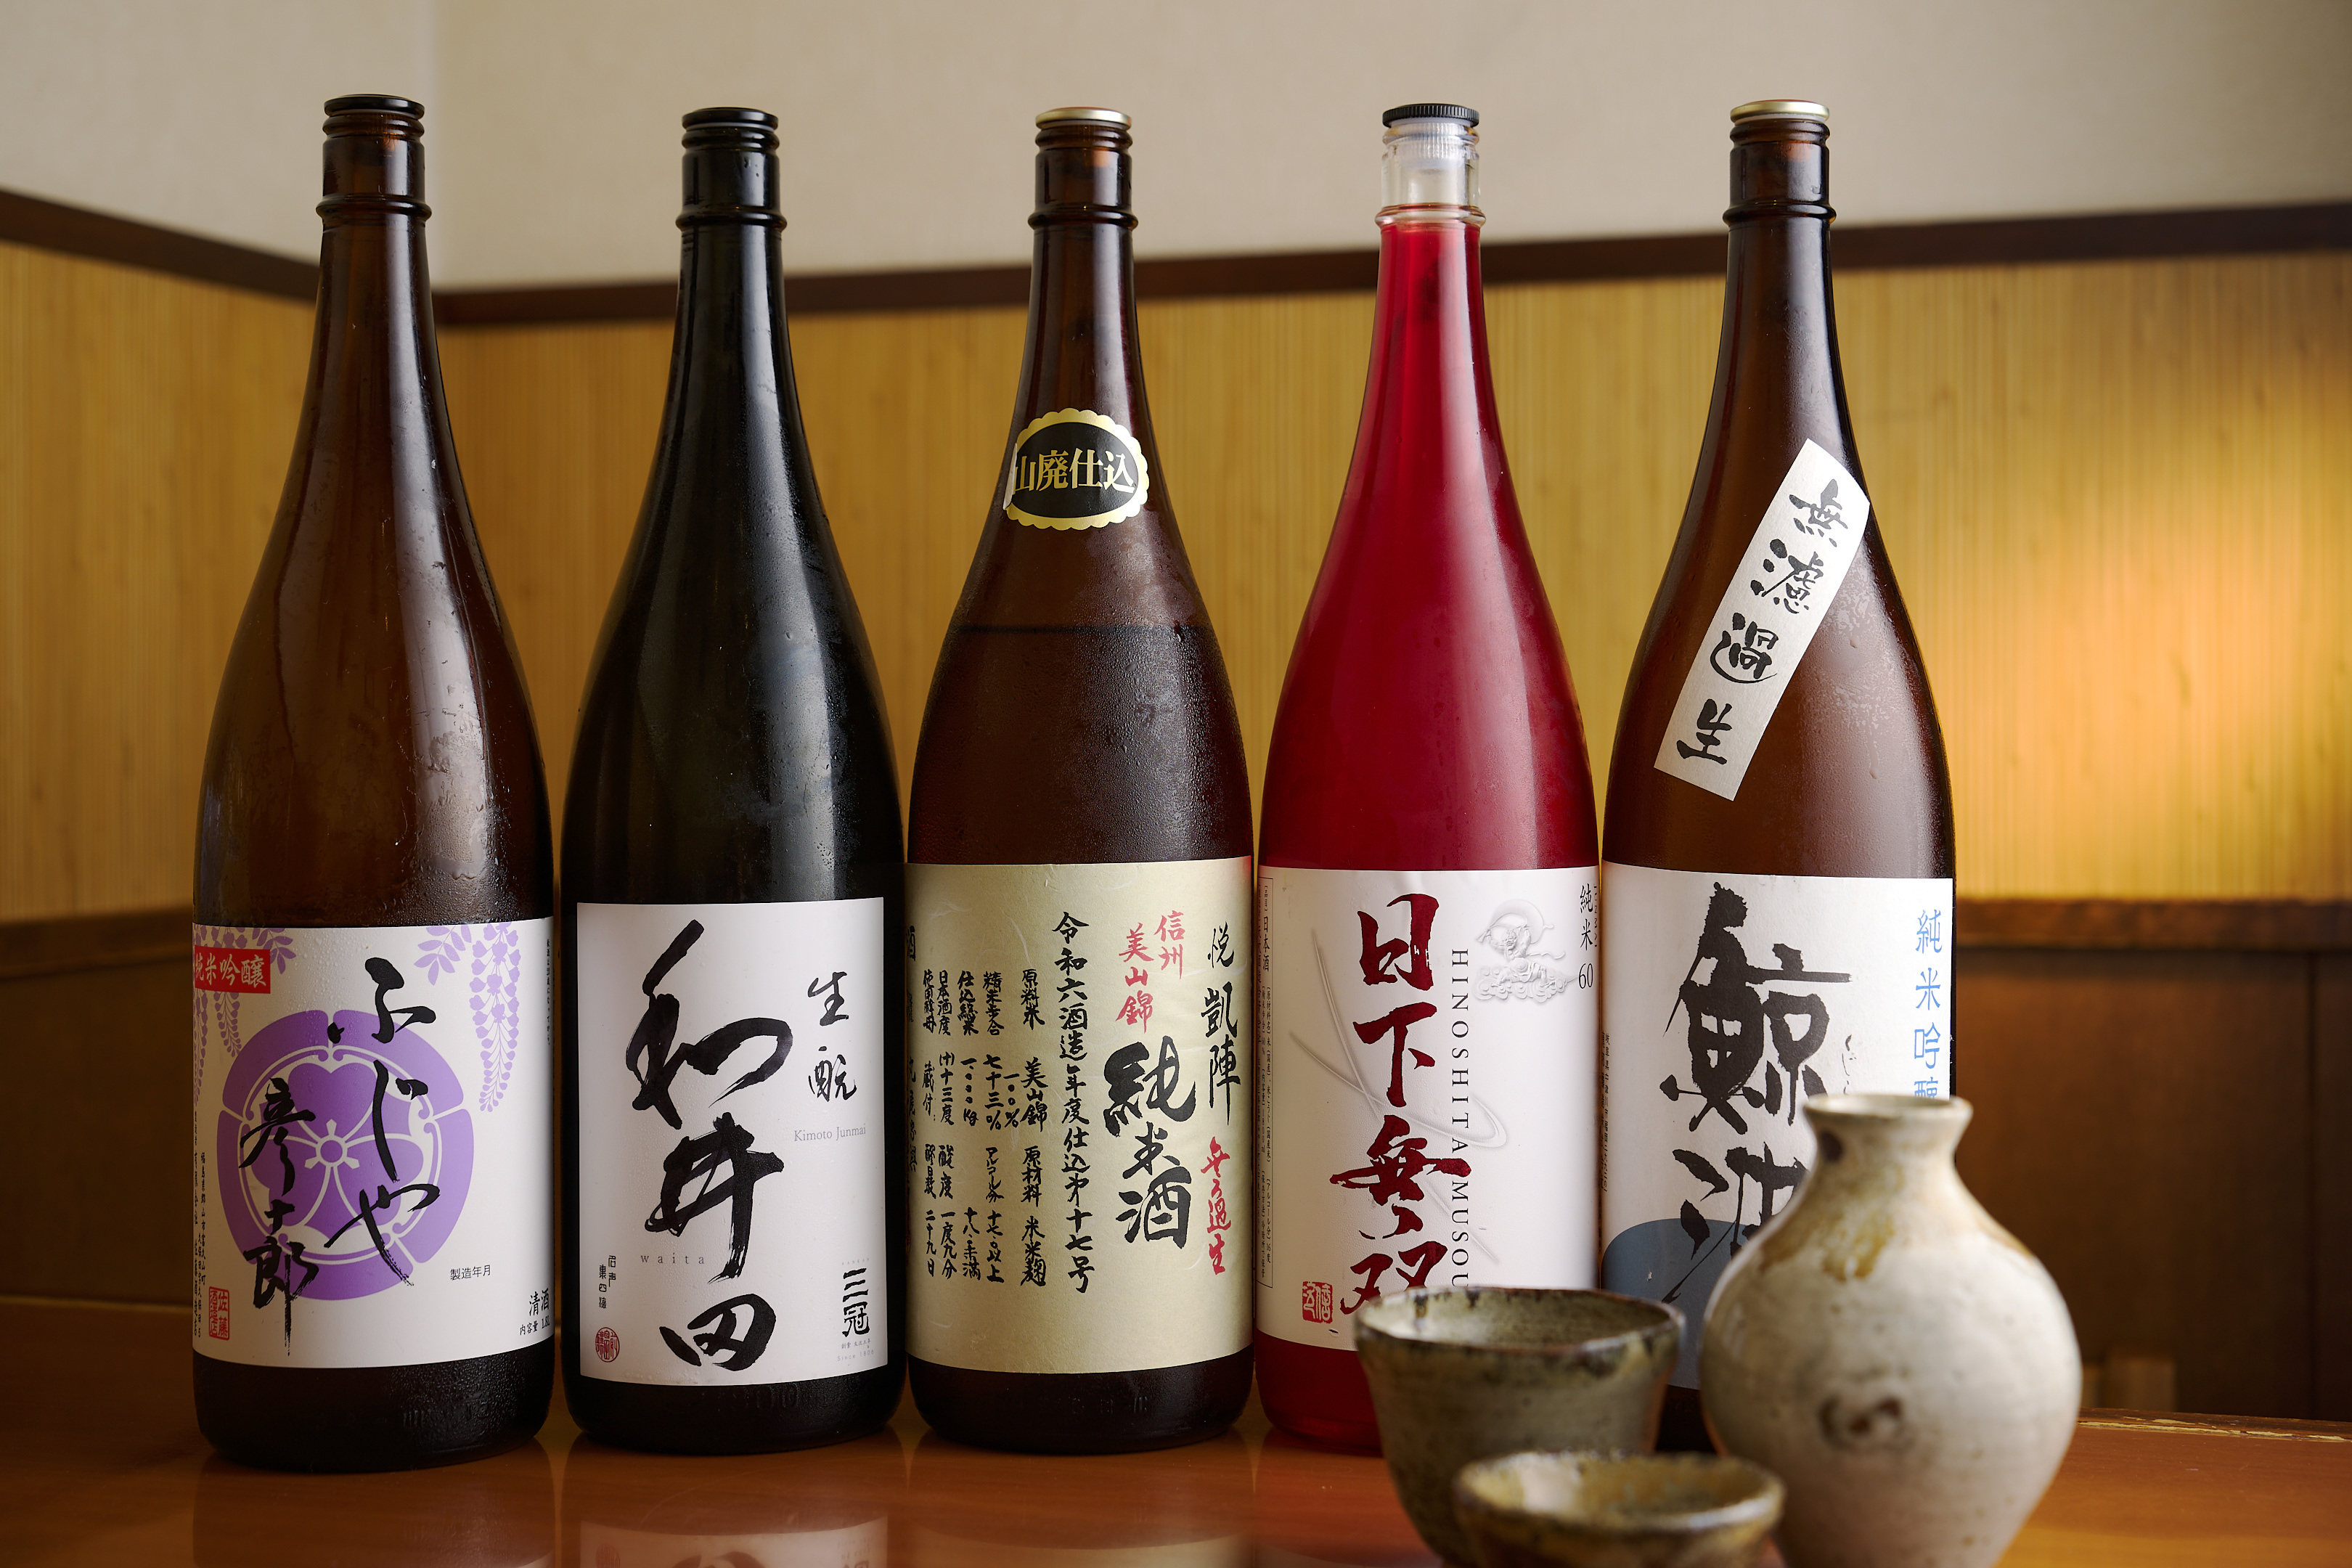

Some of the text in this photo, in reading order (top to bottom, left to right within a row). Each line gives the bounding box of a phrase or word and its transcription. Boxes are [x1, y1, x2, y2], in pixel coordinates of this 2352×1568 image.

[1015, 448, 1135, 494] 山廃仕込
[1675, 478, 1849, 765] 無濾過生
[195, 952, 266, 988] 純米吟醸
[1154, 909, 1185, 980] 信州
[1578, 883, 1593, 989] 純米 60
[937, 969, 953, 1037] 日本酒度
[982, 971, 1005, 1036] 精米歩合
[1020, 968, 1046, 1031] 原料米
[1115, 923, 1155, 1034] 美山錦
[324, 957, 441, 1286] ふじや
[1019, 1056, 1049, 1132] 美山錦
[1451, 947, 1469, 1287] HINOSHITA MUSOU
[626, 919, 793, 1372] 和井田
[793, 1124, 867, 1143] Kimoto Junmai
[1103, 1035, 1196, 1249] 純米酒
[938, 1144, 955, 1199] 酸度
[1021, 1145, 1043, 1208] 原材料
[449, 1265, 491, 1281] 製造年月
[528, 1288, 550, 1316] 清酒
[841, 1267, 870, 1338] 三冠
[519, 1320, 539, 1336] 内容量
